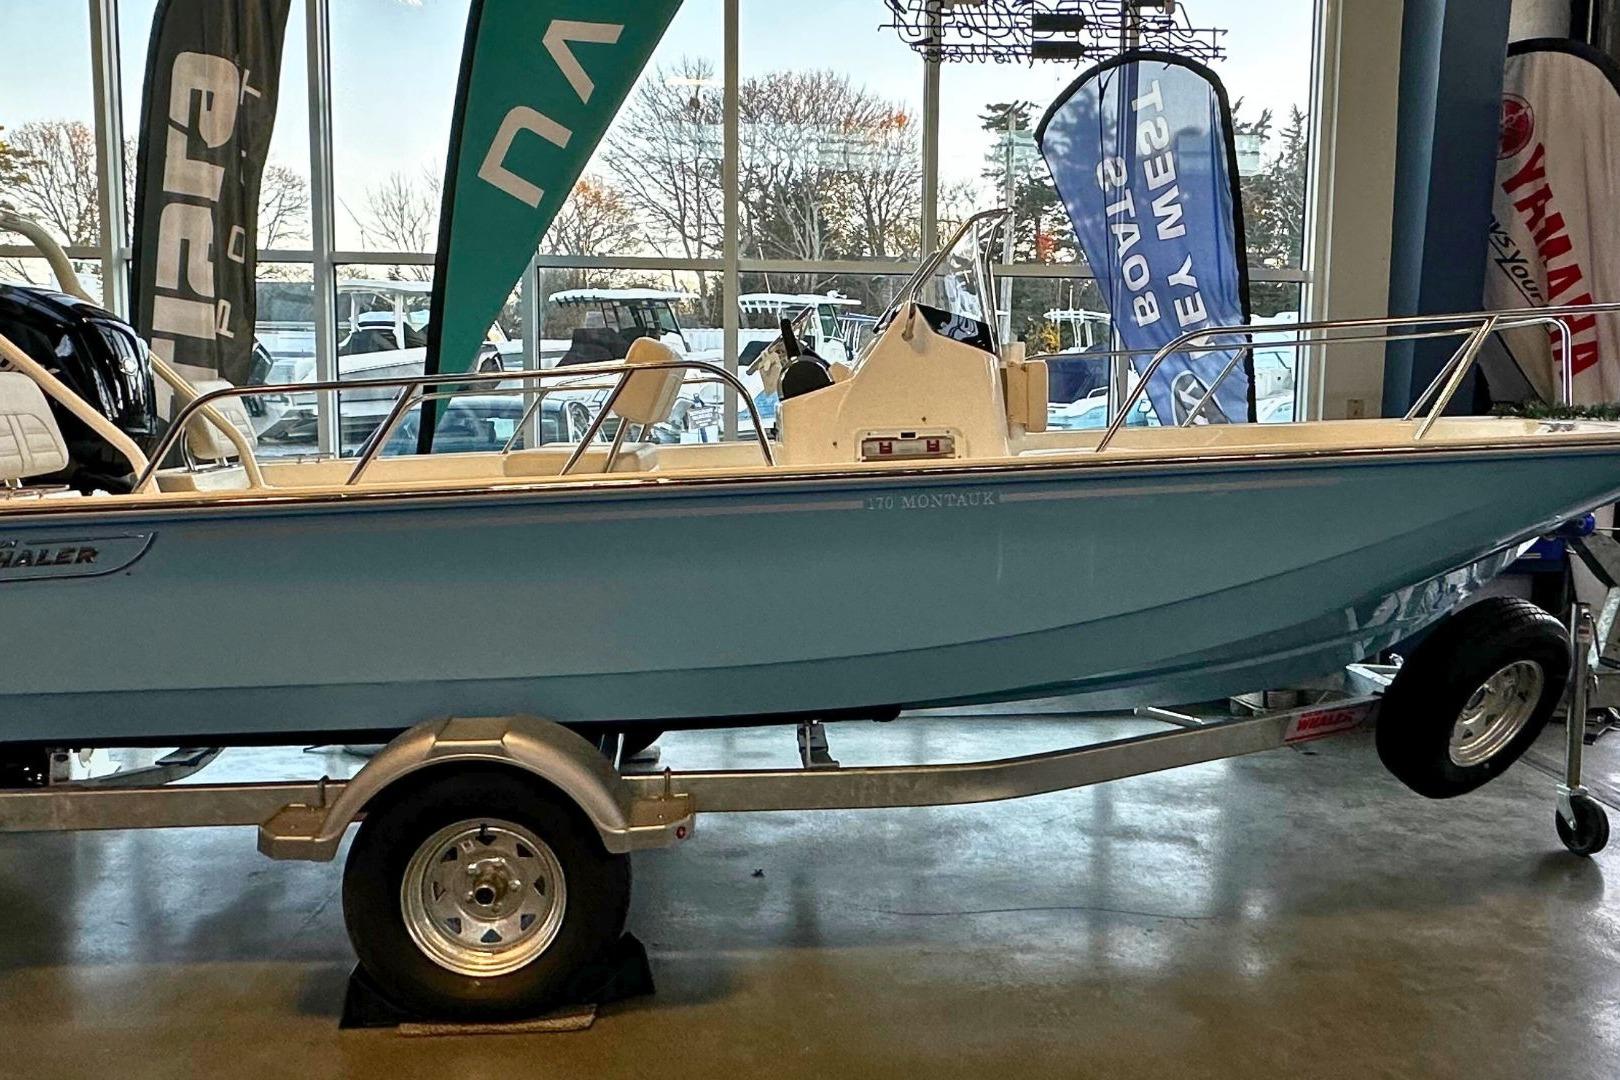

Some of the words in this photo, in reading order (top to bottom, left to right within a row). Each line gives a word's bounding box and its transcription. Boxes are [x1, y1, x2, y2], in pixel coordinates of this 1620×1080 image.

[1494, 249, 1544, 302] Your
[1501, 142, 1599, 380] YAMAHA
[868, 495, 894, 510] 170
[901, 491, 996, 509] MONTAUK
